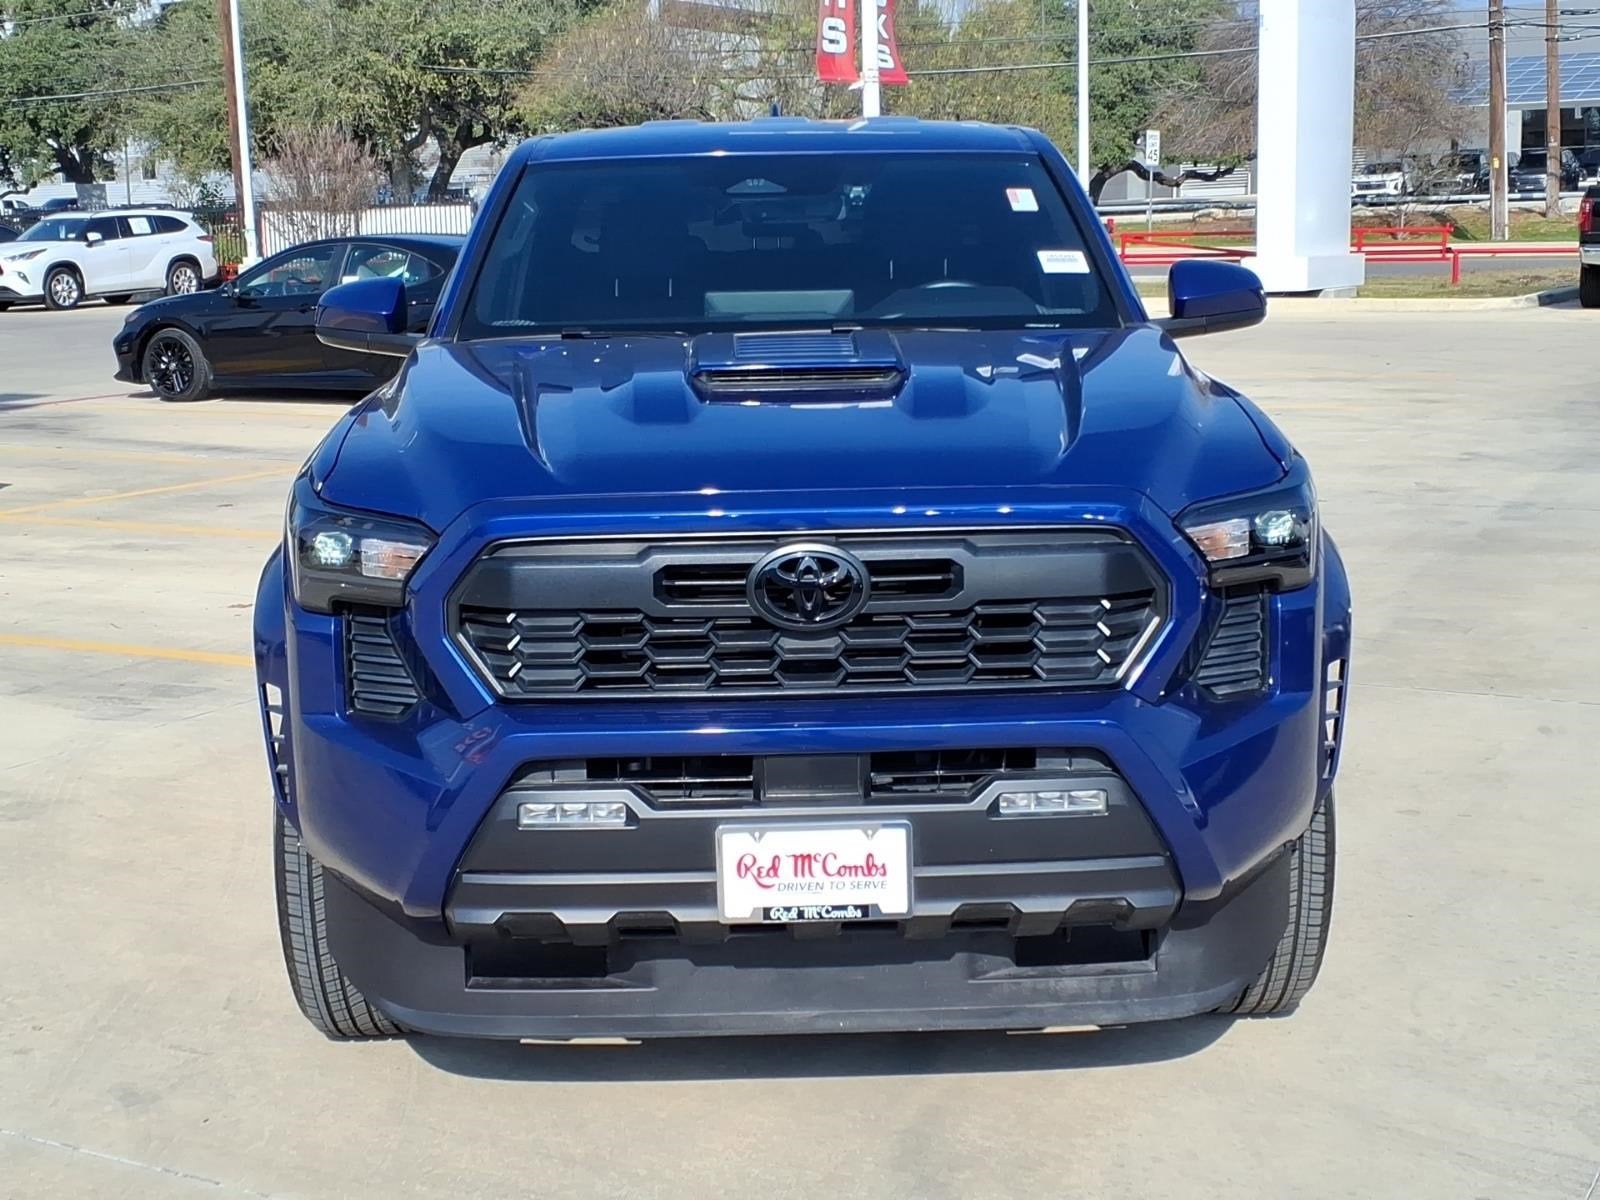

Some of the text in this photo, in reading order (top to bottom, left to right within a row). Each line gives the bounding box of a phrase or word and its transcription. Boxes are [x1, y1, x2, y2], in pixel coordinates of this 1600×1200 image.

[1148, 149, 1158, 161] 45
[736, 852, 887, 888] Red McCombs
[777, 880, 888, 892] DRIVEN TO SERVE
[769, 905, 862, 921] Red McCombs
